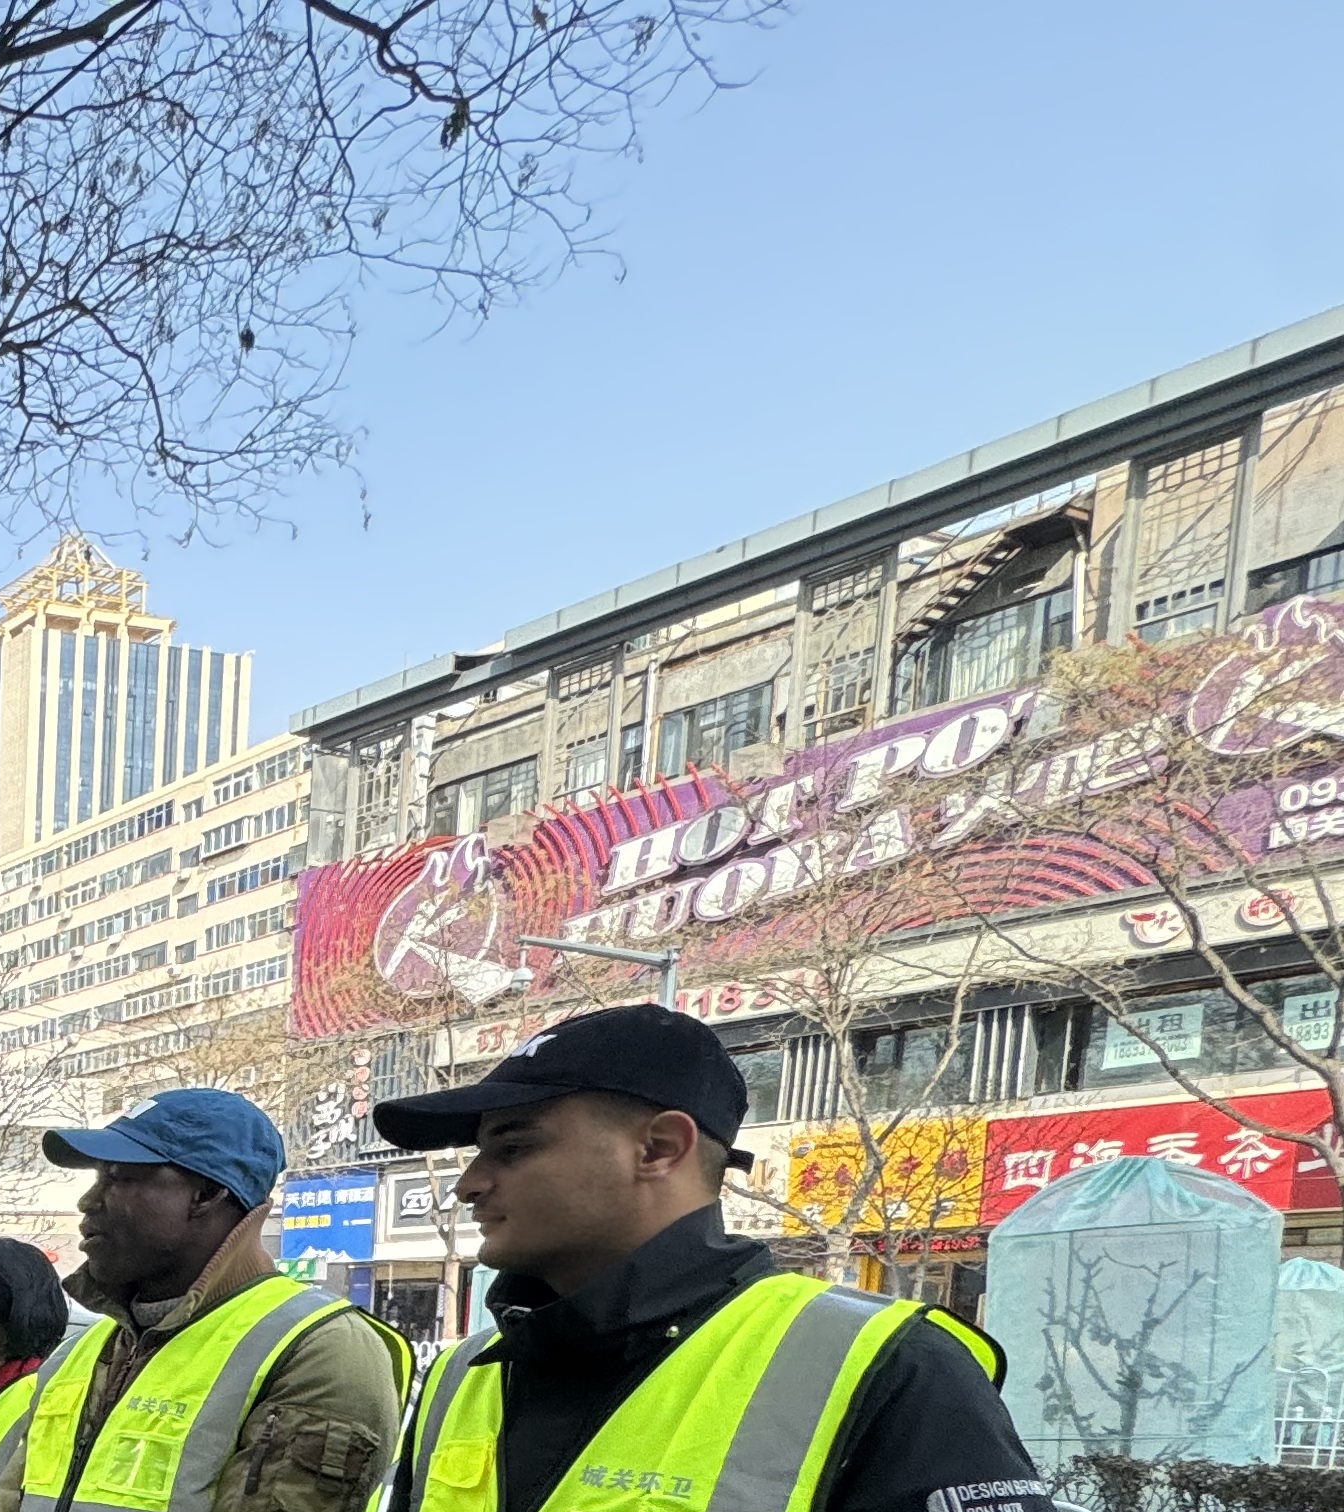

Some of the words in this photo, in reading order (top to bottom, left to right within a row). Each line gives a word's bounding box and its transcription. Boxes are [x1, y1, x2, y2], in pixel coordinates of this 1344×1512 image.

[581, 1464, 694, 1499] 城关环卫
[957, 1480, 1015, 1501] DESIGN
